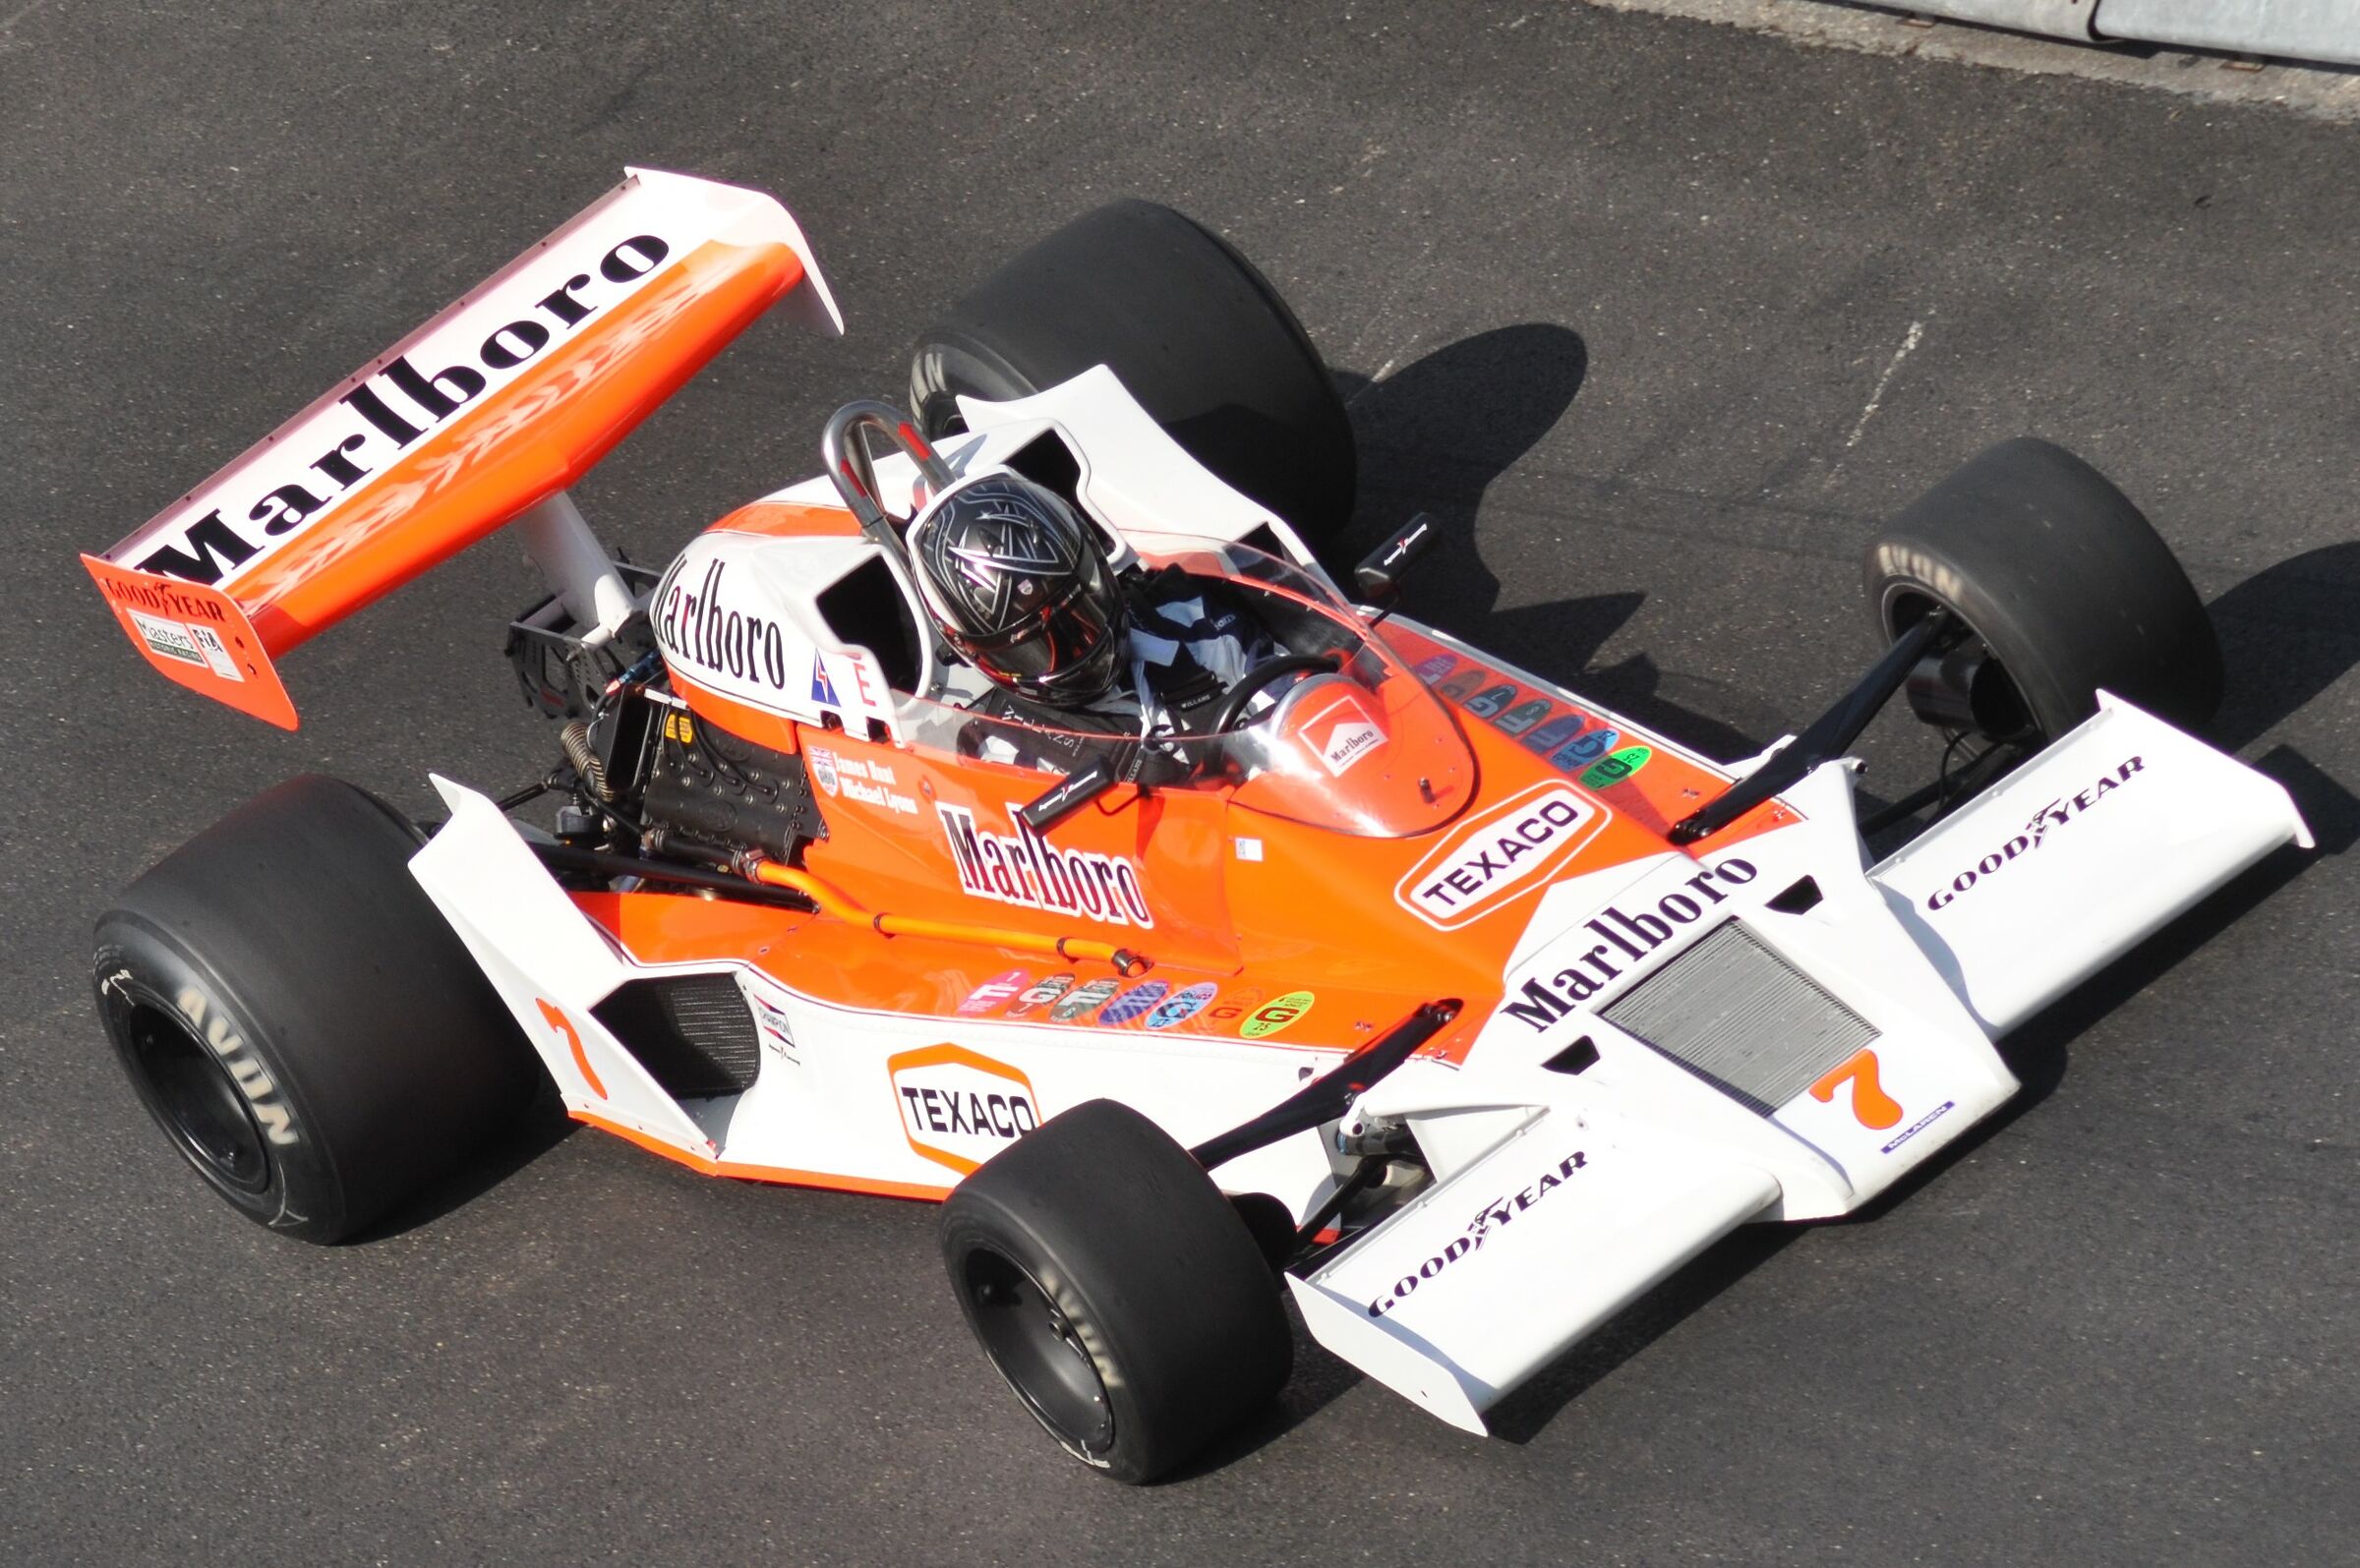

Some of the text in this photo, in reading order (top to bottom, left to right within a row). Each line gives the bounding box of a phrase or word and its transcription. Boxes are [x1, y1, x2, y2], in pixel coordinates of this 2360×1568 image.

[134, 233, 671, 586] Marlboro
[649, 552, 786, 691] Marlboro
[1330, 729, 1375, 763] Marlboro
[939, 805, 1151, 924] Marlboro
[1422, 799, 1579, 907] TEXACO
[1927, 755, 2146, 911] GOODYEAR
[1500, 857, 1758, 1033] Marlboro
[176, 985, 299, 1145] AVON
[535, 997, 608, 1100] 7
[1808, 1048, 1904, 1131] 7
[901, 1086, 1036, 1140] TEXACO
[1887, 1106, 1947, 1150] McLAREN
[1368, 1149, 1590, 1317] GOODYEAR
